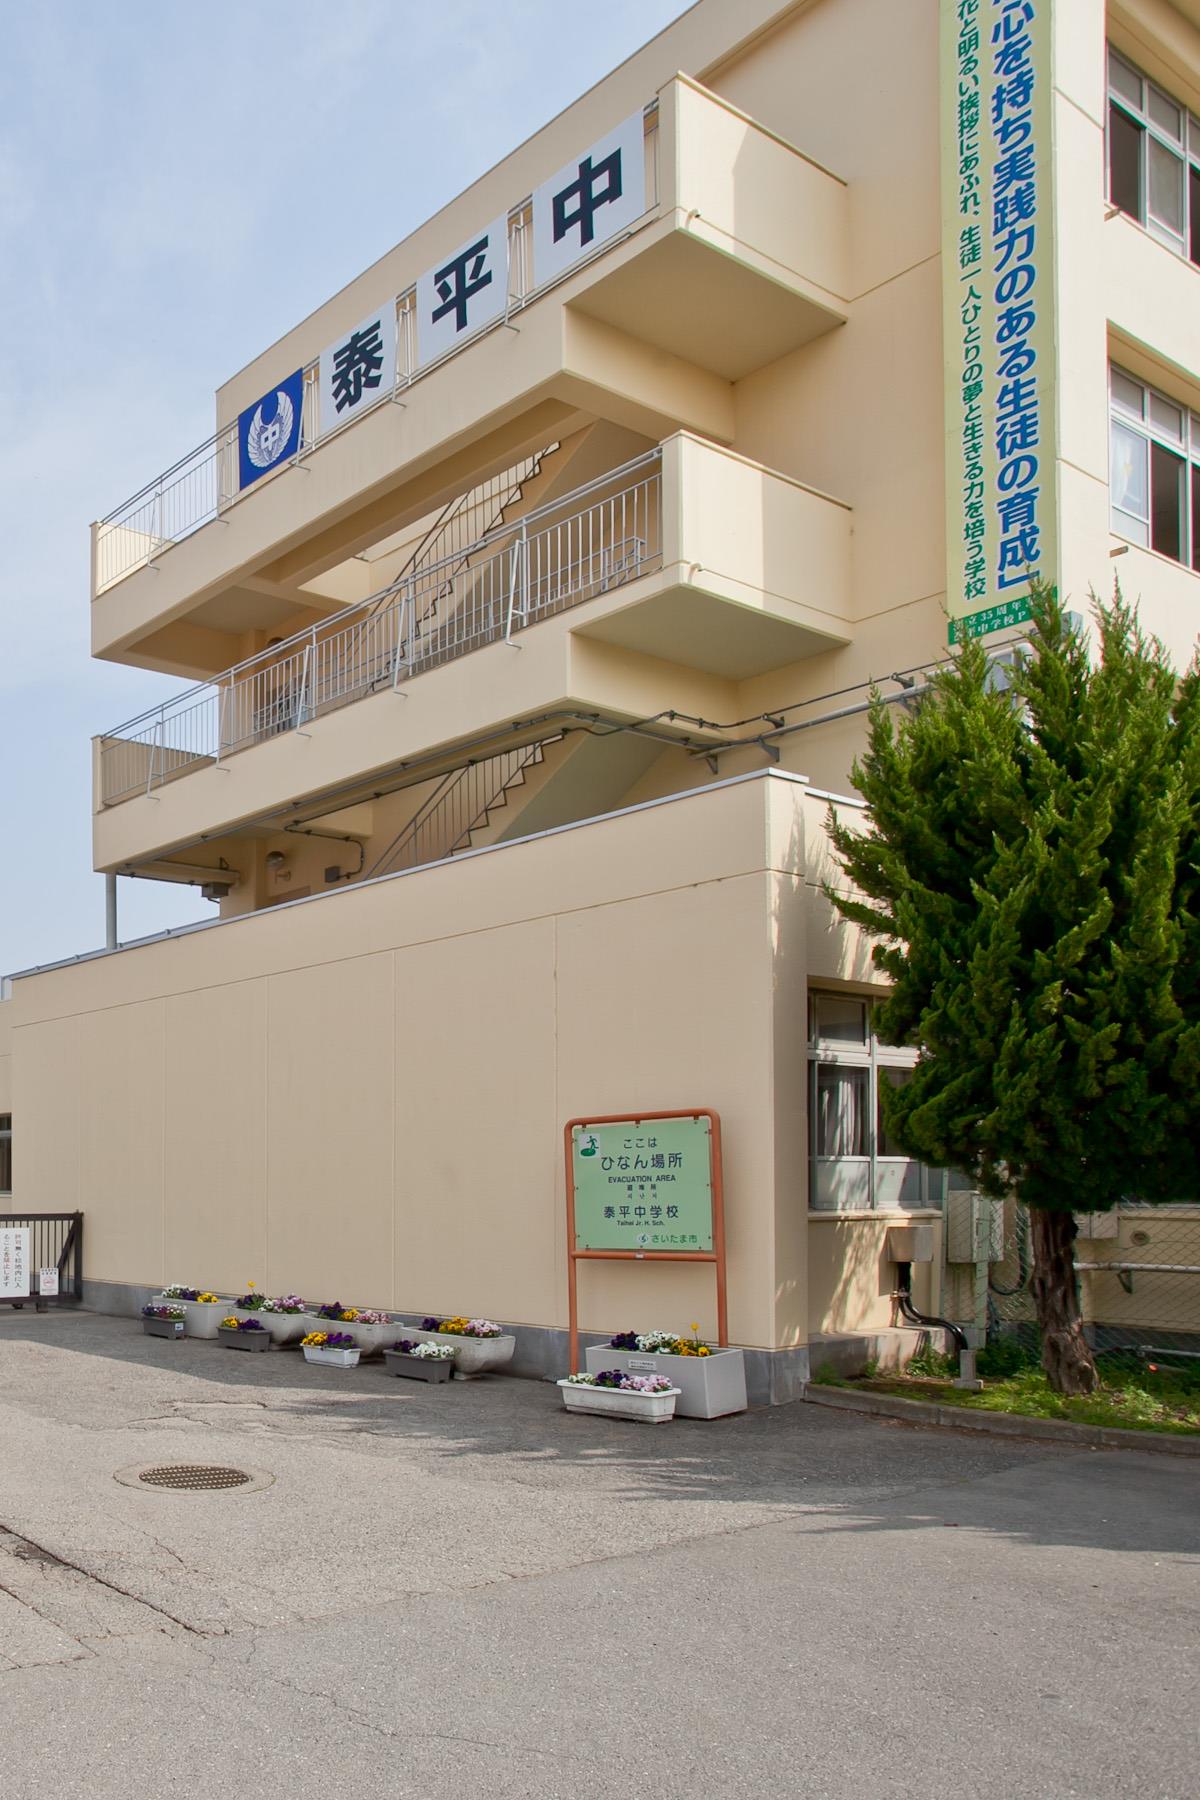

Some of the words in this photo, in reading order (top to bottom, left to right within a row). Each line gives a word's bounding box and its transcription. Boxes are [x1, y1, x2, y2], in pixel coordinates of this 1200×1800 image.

[991, 0, 1041, 590] 心を持ち実践力のある生徒の育成」
[623, 1137, 657, 1149] ここは
[601, 1152, 683, 1171] ひなん場所
[608, 1175, 652, 1183] EVACUATION
[603, 1205, 679, 1219] 泰平中学校
[651, 1234, 697, 1243] さいたま市
